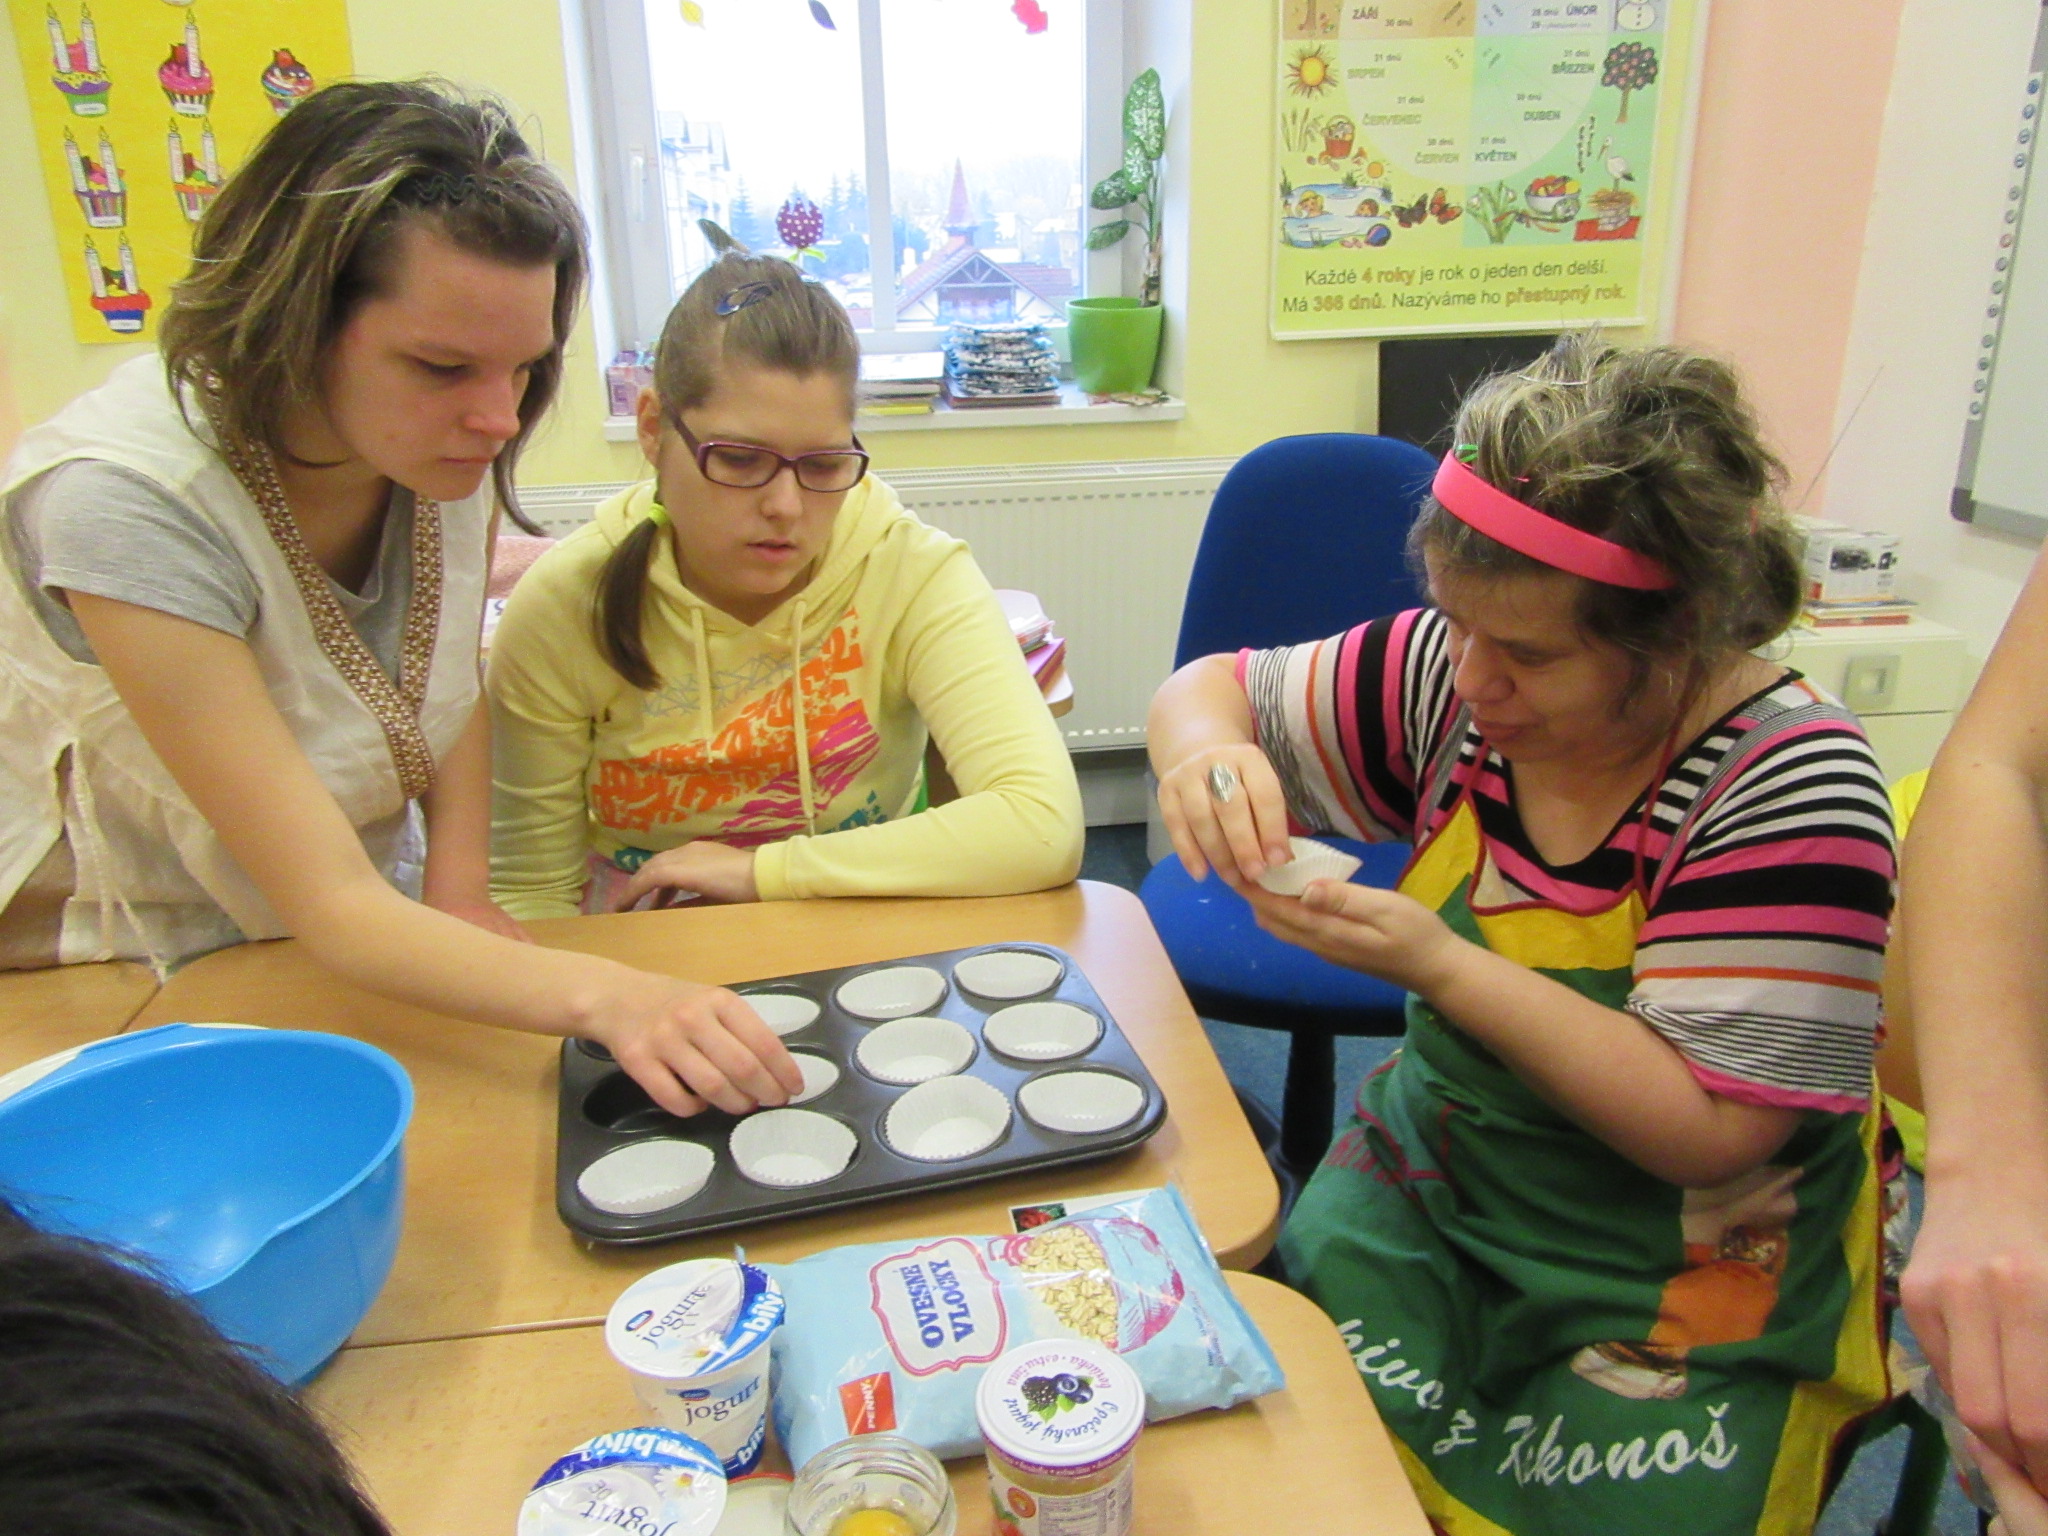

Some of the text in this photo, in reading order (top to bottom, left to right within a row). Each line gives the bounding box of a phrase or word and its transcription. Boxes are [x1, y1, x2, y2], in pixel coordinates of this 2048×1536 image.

[1566, 3, 1598, 16] ÚNOR
[1552, 61, 1595, 74] BŘEZEN
[1362, 114, 1422, 126] ČERVENEC
[1523, 110, 1561, 121] DUBEN
[1414, 151, 1460, 164] ČERVEN
[1475, 150, 1517, 162] KVĚTEN
[1305, 259, 1608, 286] Každé 4 roky je rok o jeden den delší.
[1283, 296, 1308, 312] Má
[1348, 292, 1386, 310] dnů.
[1392, 290, 1476, 311] Nazýváme
[1481, 290, 1500, 304] ho
[1505, 284, 1592, 307] přestupný
[1595, 283, 1626, 300] rok.
[893, 1264, 945, 1349] OVESNÉ
[928, 1259, 975, 1343] VLOČKY
[636, 1286, 707, 1350] jogurt
[684, 1374, 762, 1427] jogurt
[1002, 1398, 1043, 1435] jogurt
[1432, 1409, 1478, 1455] z
